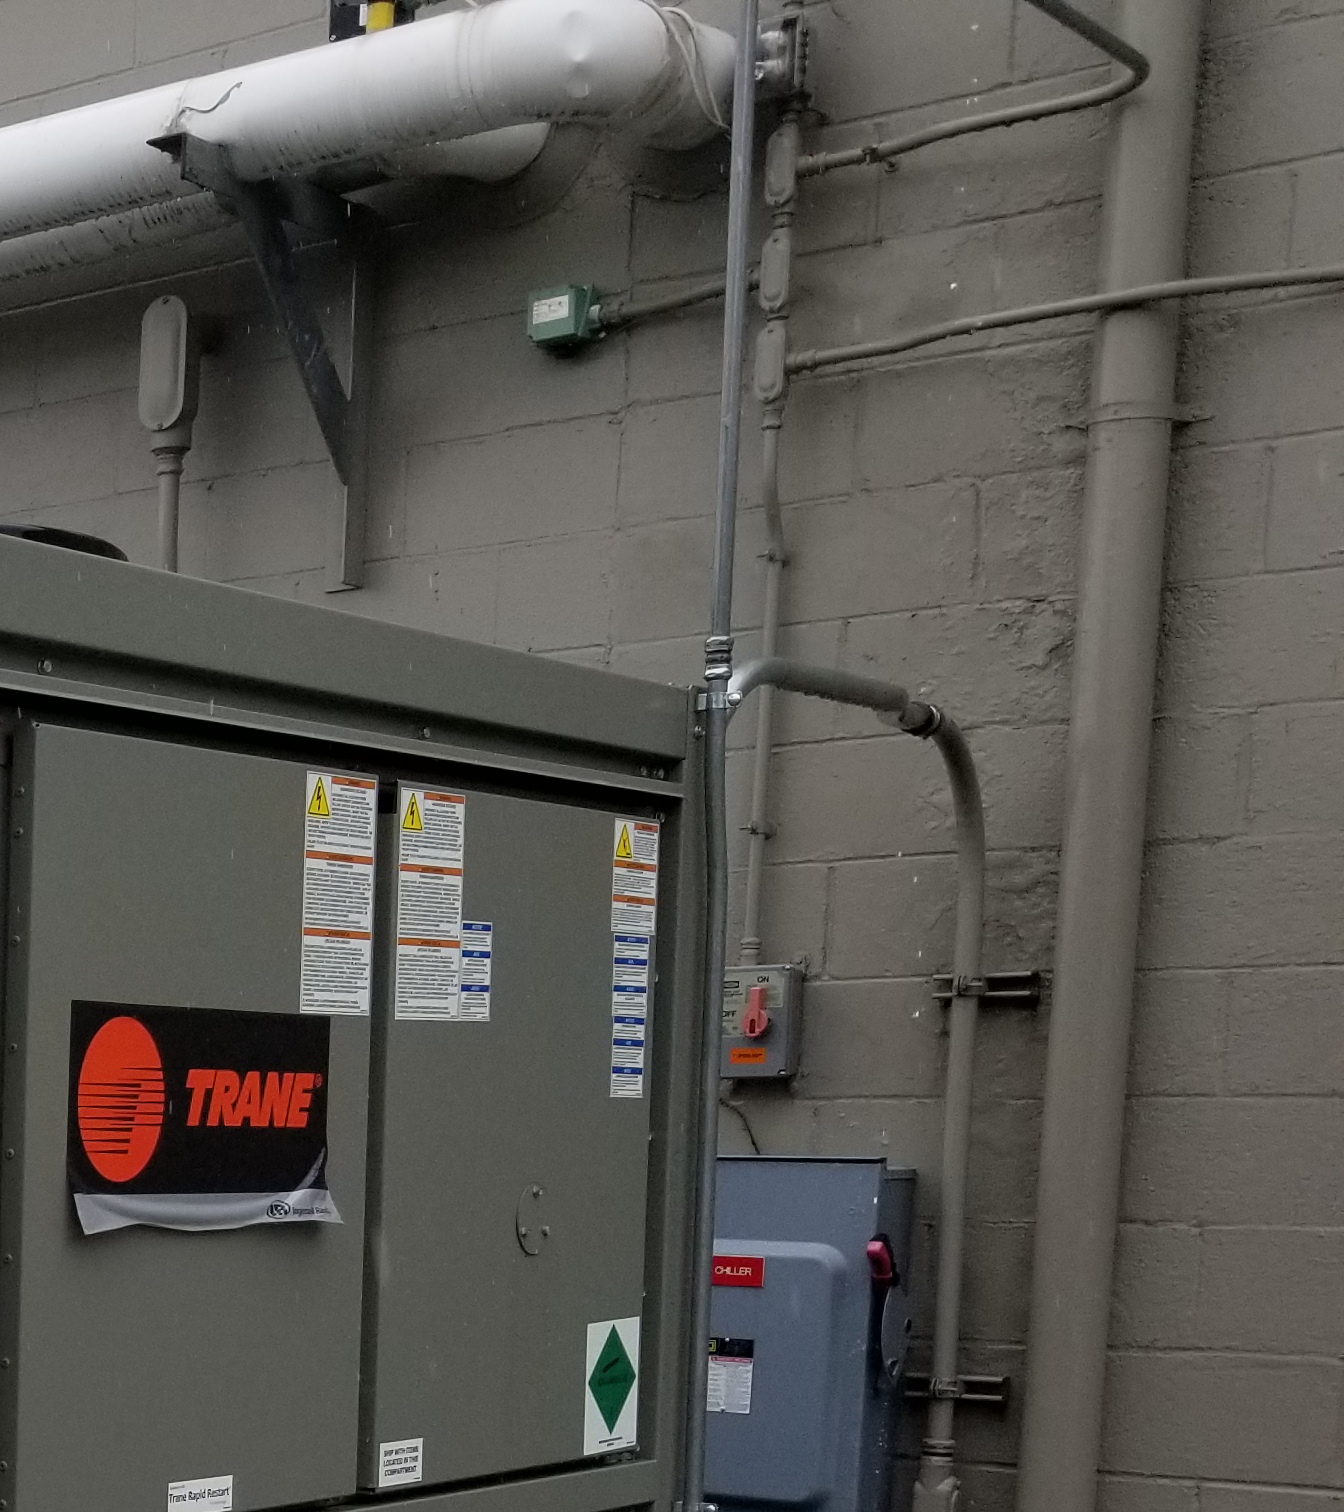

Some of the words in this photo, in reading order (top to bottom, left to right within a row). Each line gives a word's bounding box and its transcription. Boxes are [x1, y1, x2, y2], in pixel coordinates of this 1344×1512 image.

[186, 1068, 316, 1129] TRANE
[714, 1265, 752, 1276] CHILLER
[169, 1493, 187, 1504] Trane
[188, 1489, 206, 1503] Rapid
[207, 1486, 230, 1499] Restart
